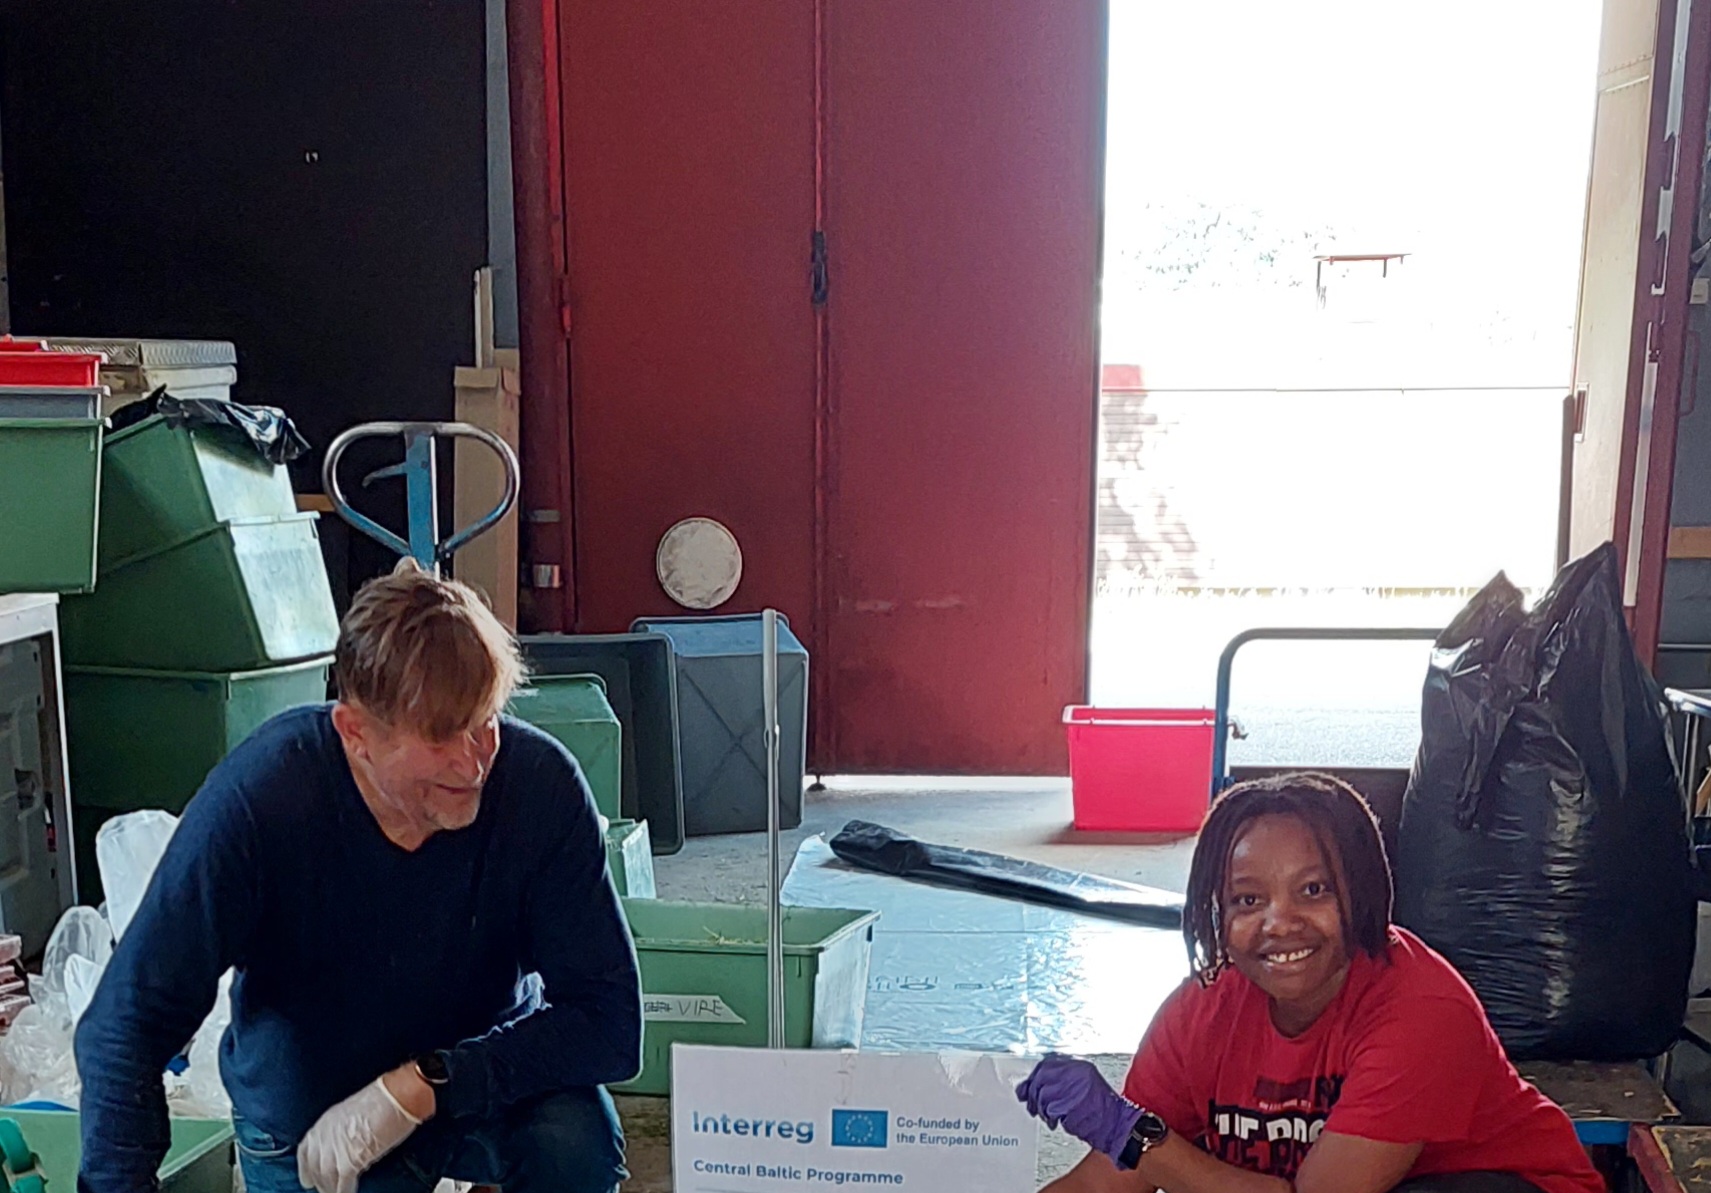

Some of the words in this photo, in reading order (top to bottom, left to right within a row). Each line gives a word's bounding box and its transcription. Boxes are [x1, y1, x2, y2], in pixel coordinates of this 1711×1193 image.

[692, 1111, 814, 1143] Interreg
[896, 1117, 961, 1130] Co-funded
[964, 1119, 980, 1133] by
[896, 1132, 915, 1145] the
[919, 1133, 978, 1147] European
[981, 1135, 1019, 1147] Union
[693, 1160, 751, 1177] Central
[755, 1165, 802, 1180] Baltic
[806, 1169, 904, 1186] Programme
